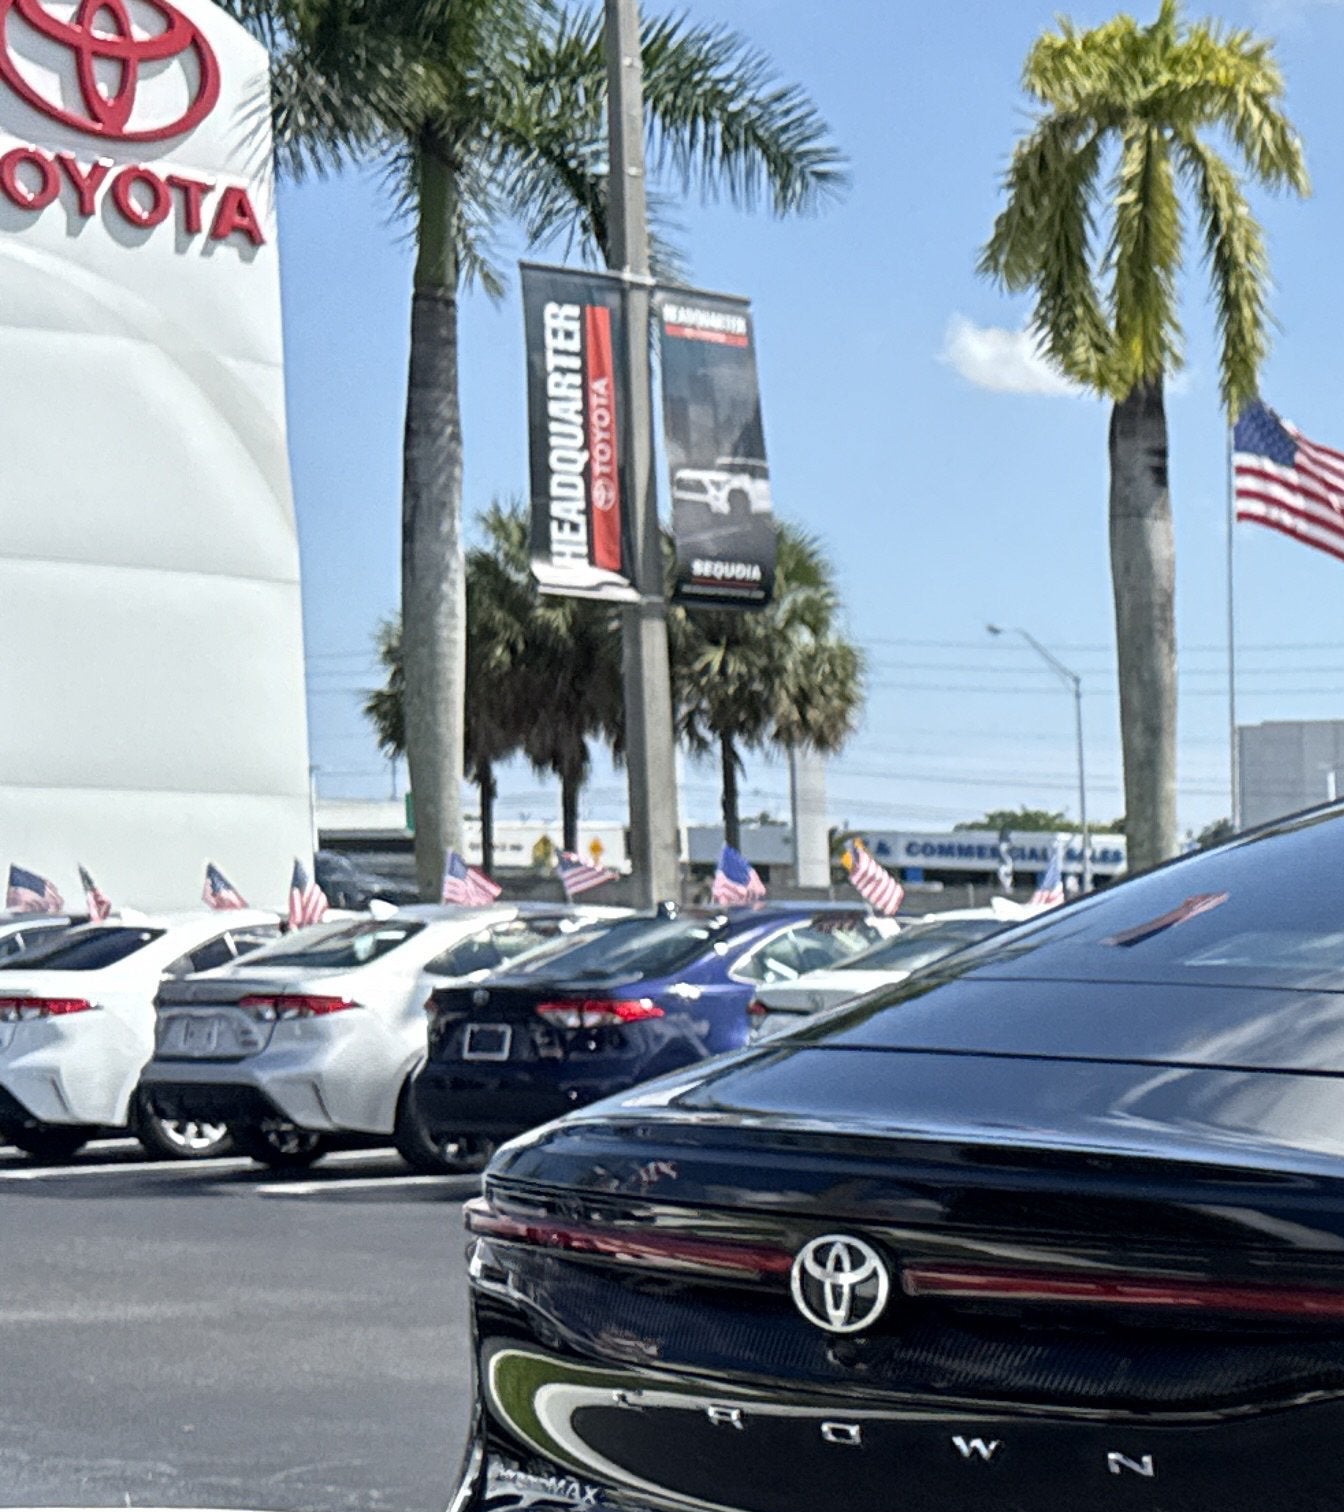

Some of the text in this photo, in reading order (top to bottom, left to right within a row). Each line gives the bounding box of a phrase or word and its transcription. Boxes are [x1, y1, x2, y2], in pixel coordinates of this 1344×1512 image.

[0, 147, 266, 246] OYOTA
[543, 301, 589, 567] HEADQUARTER
[591, 377, 613, 474] TOYOTA
[691, 558, 762, 581] SEQUOIA
